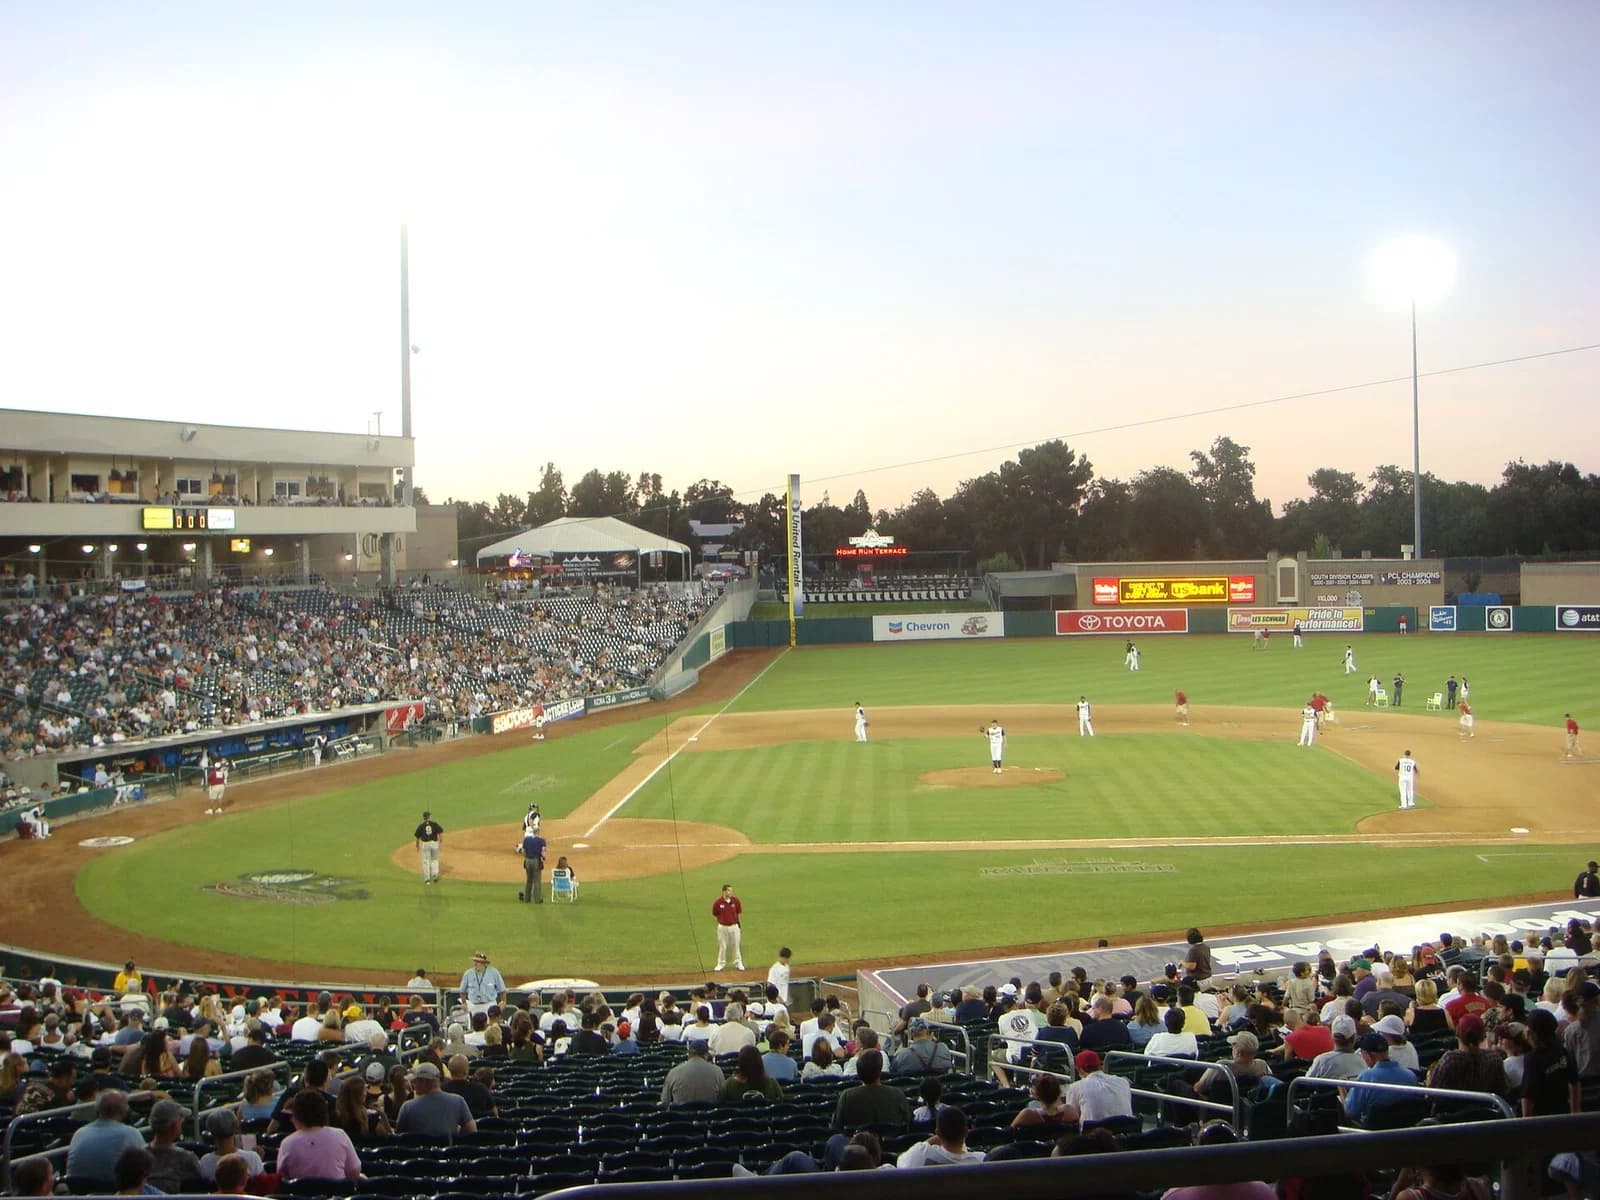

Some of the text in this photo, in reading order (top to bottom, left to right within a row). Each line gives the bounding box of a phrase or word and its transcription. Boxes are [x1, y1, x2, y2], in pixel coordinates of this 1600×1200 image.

[1309, 609, 1332, 619] Pride
[906, 621, 950, 632] Chevron
[1104, 616, 1165, 628] TOYOTA
[1294, 619, 1358, 629] Performance!
[425, 826, 432, 835] 9
